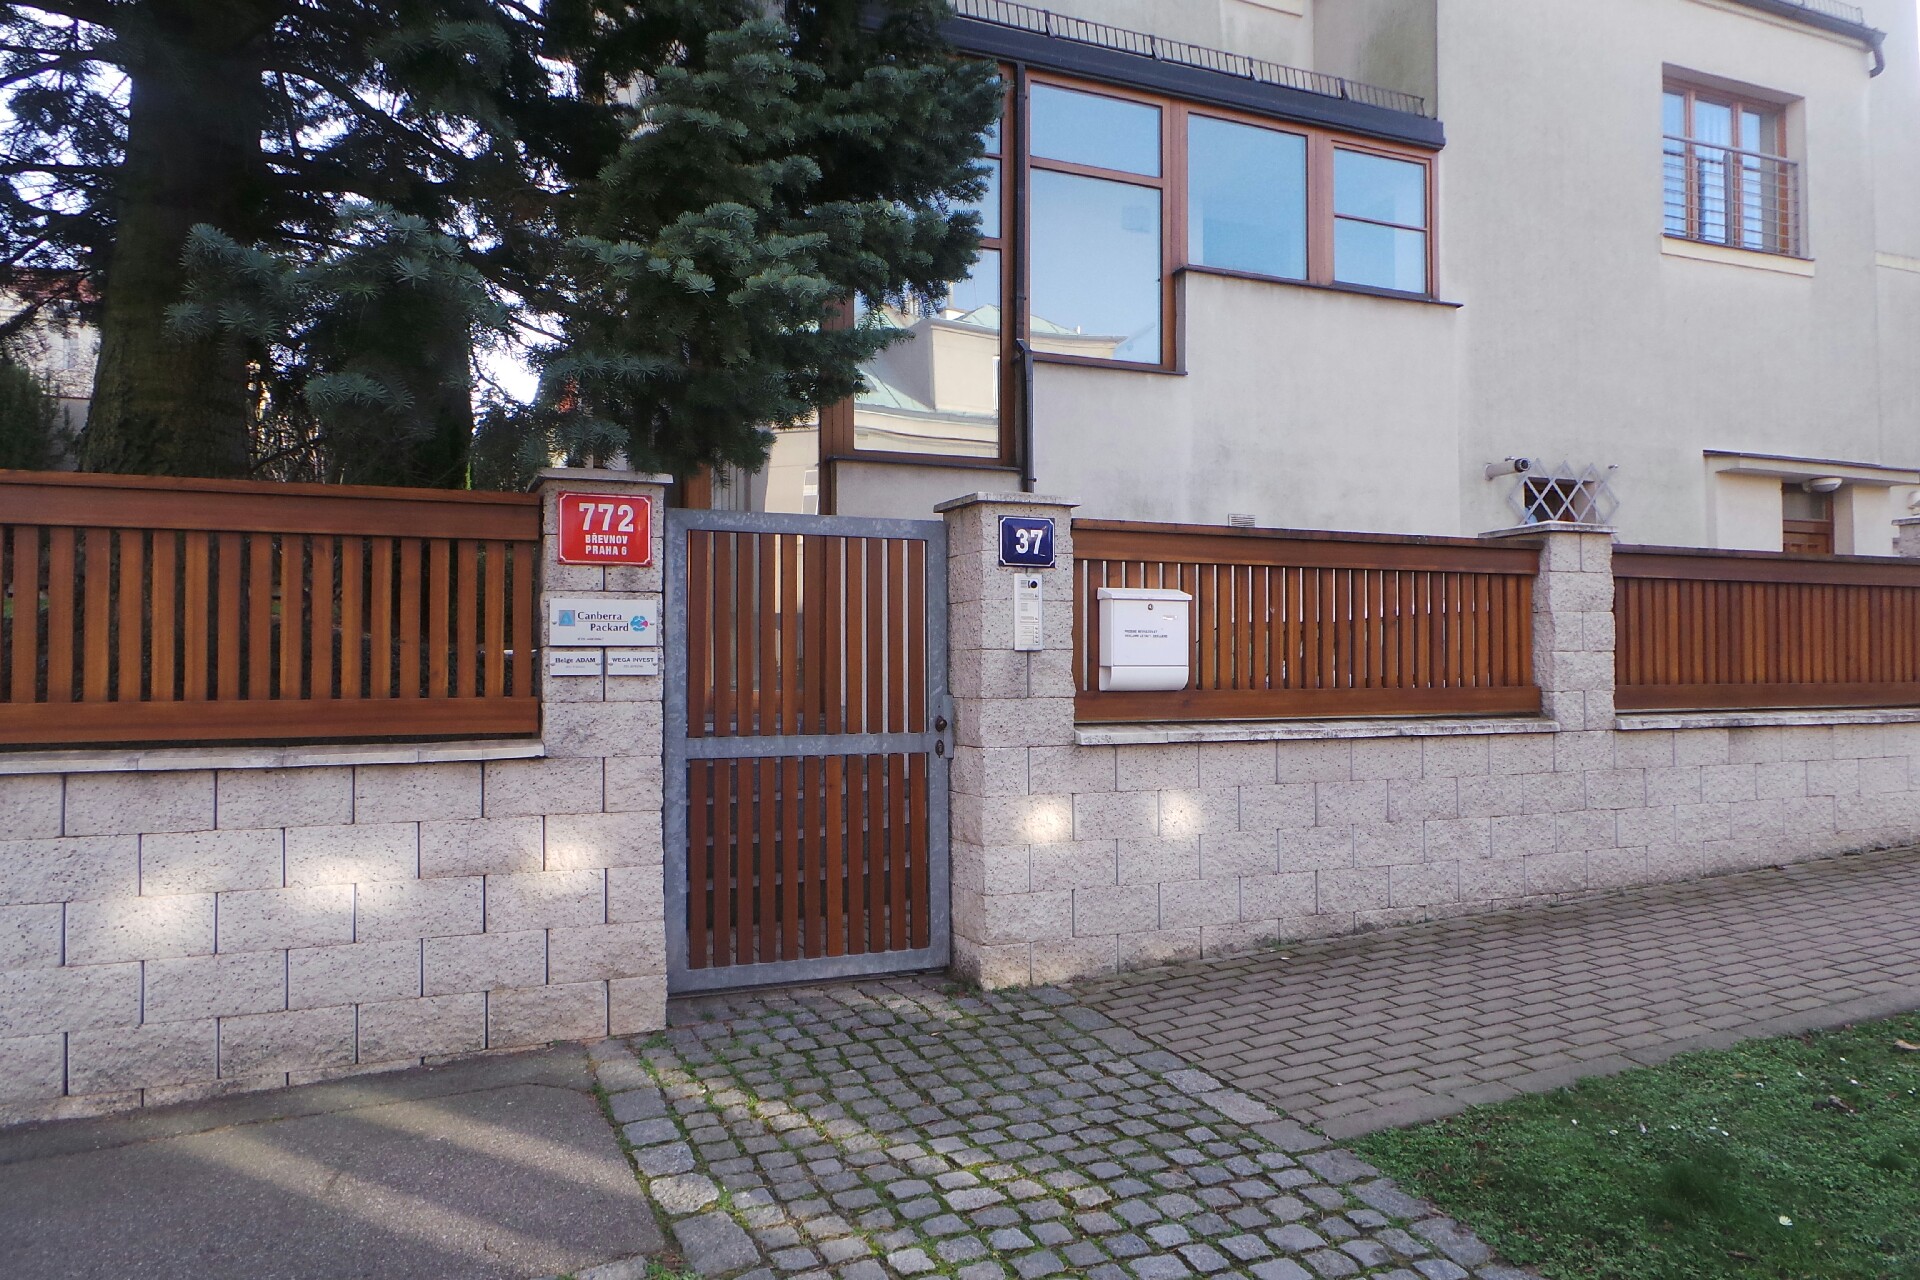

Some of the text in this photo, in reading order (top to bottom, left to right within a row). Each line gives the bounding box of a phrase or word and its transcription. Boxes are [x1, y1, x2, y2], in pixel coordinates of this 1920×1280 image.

[579, 503, 634, 532] 772
[585, 533, 628, 544] BŘEVNOV
[1015, 528, 1043, 555] 37
[585, 545, 627, 555] PRAHA 6
[577, 611, 622, 620] Canberra
[590, 622, 629, 632] Packard
